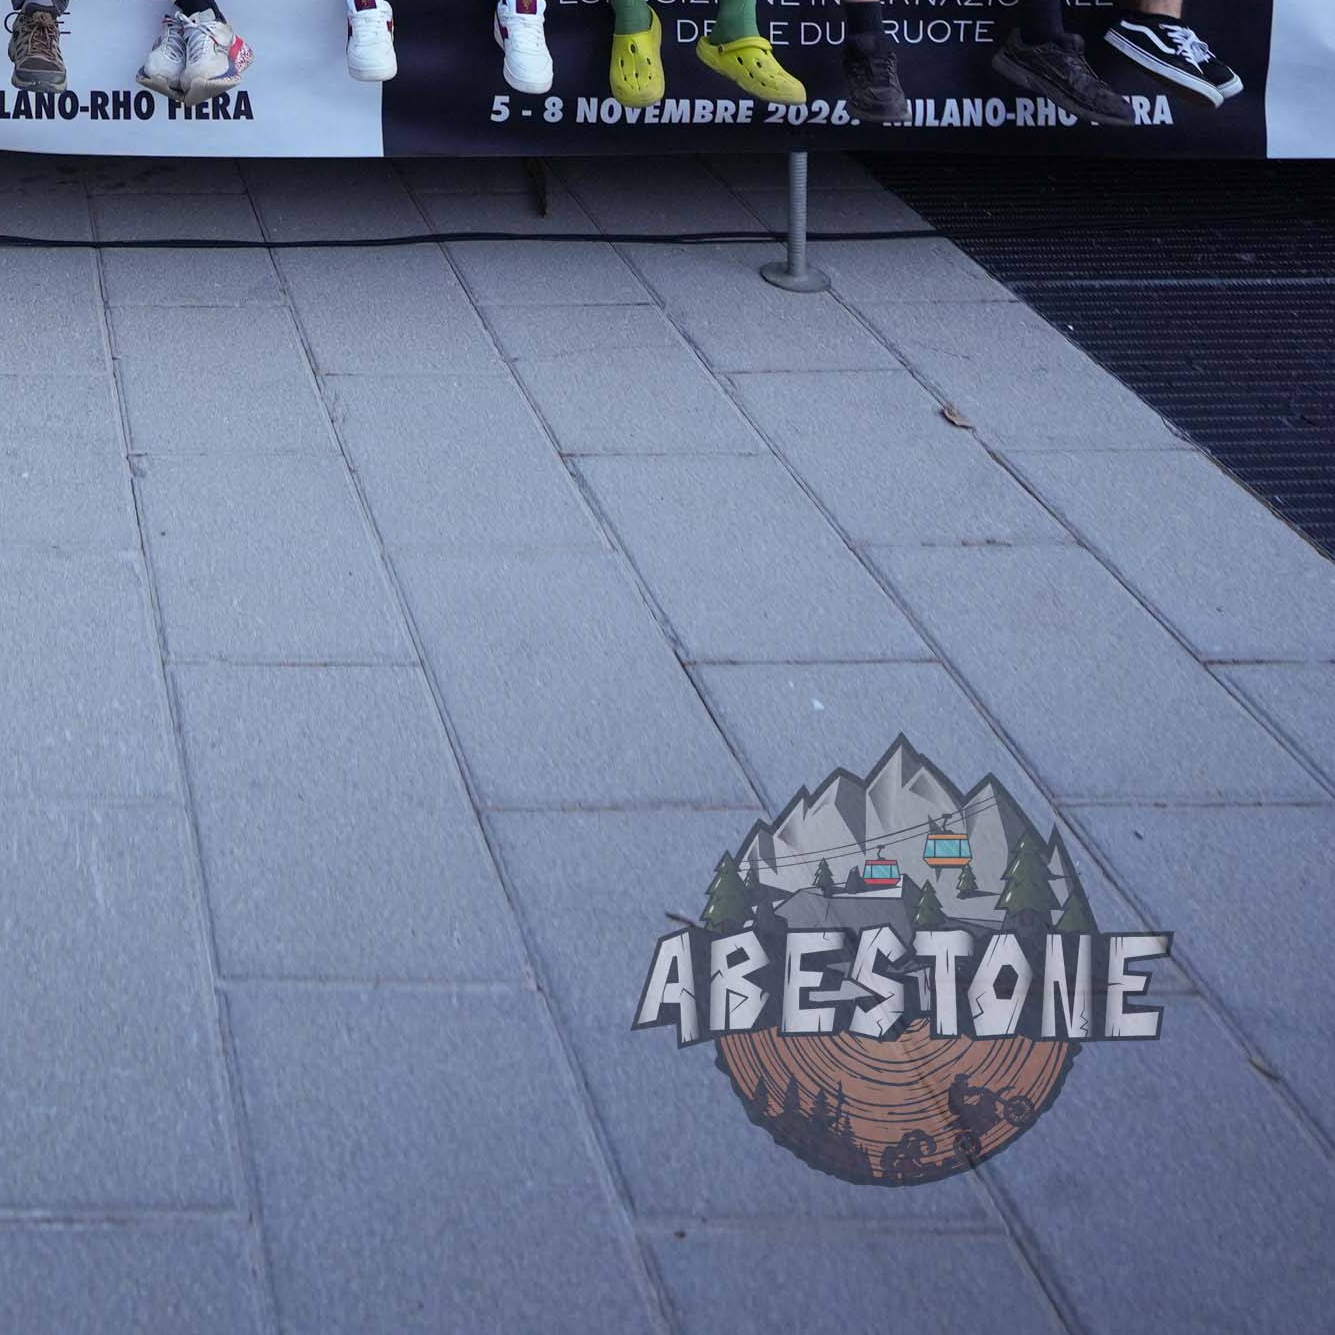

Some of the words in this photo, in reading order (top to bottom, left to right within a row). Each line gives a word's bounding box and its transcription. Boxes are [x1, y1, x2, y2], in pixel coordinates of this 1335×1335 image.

[800, 21, 846, 46] DU
[491, 95, 510, 122] 5
[544, 96, 563, 123] 8
[575, 96, 753, 124] NOVEMBRE
